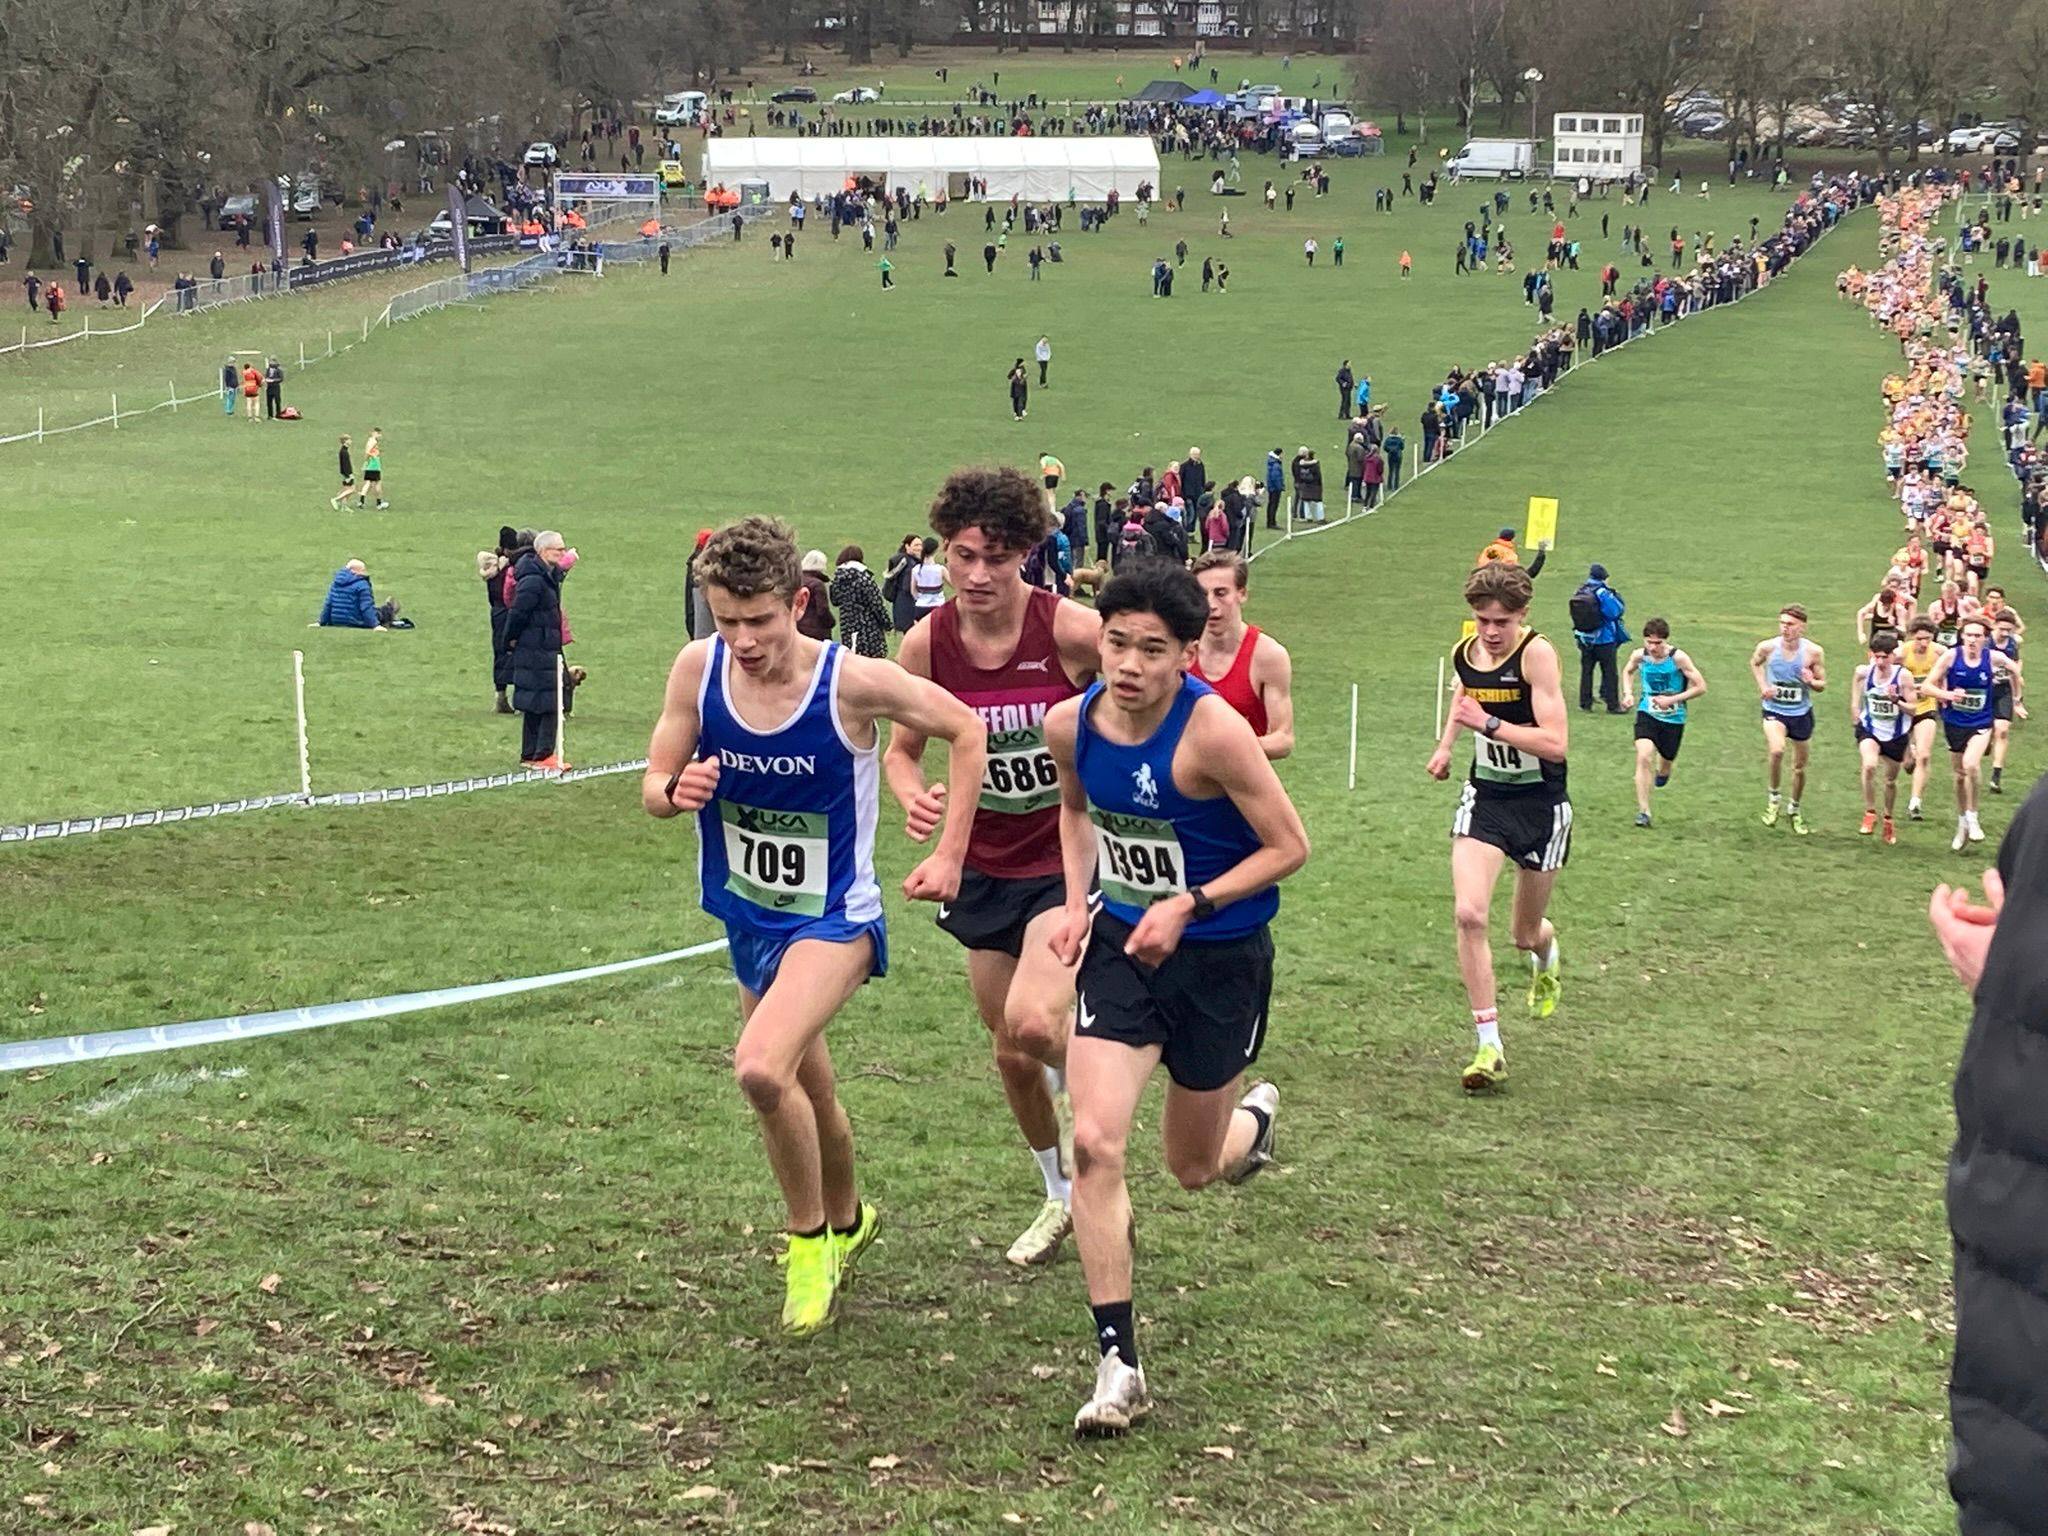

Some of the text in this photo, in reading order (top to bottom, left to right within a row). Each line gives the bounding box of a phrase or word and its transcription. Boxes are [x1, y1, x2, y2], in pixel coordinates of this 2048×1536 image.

[720, 748, 816, 775] DEVON
[1486, 741, 1522, 769] 414
[982, 752, 1058, 793] 686
[760, 811, 808, 827] UKA
[739, 833, 806, 887] 709
[1102, 834, 1178, 886] 1394
